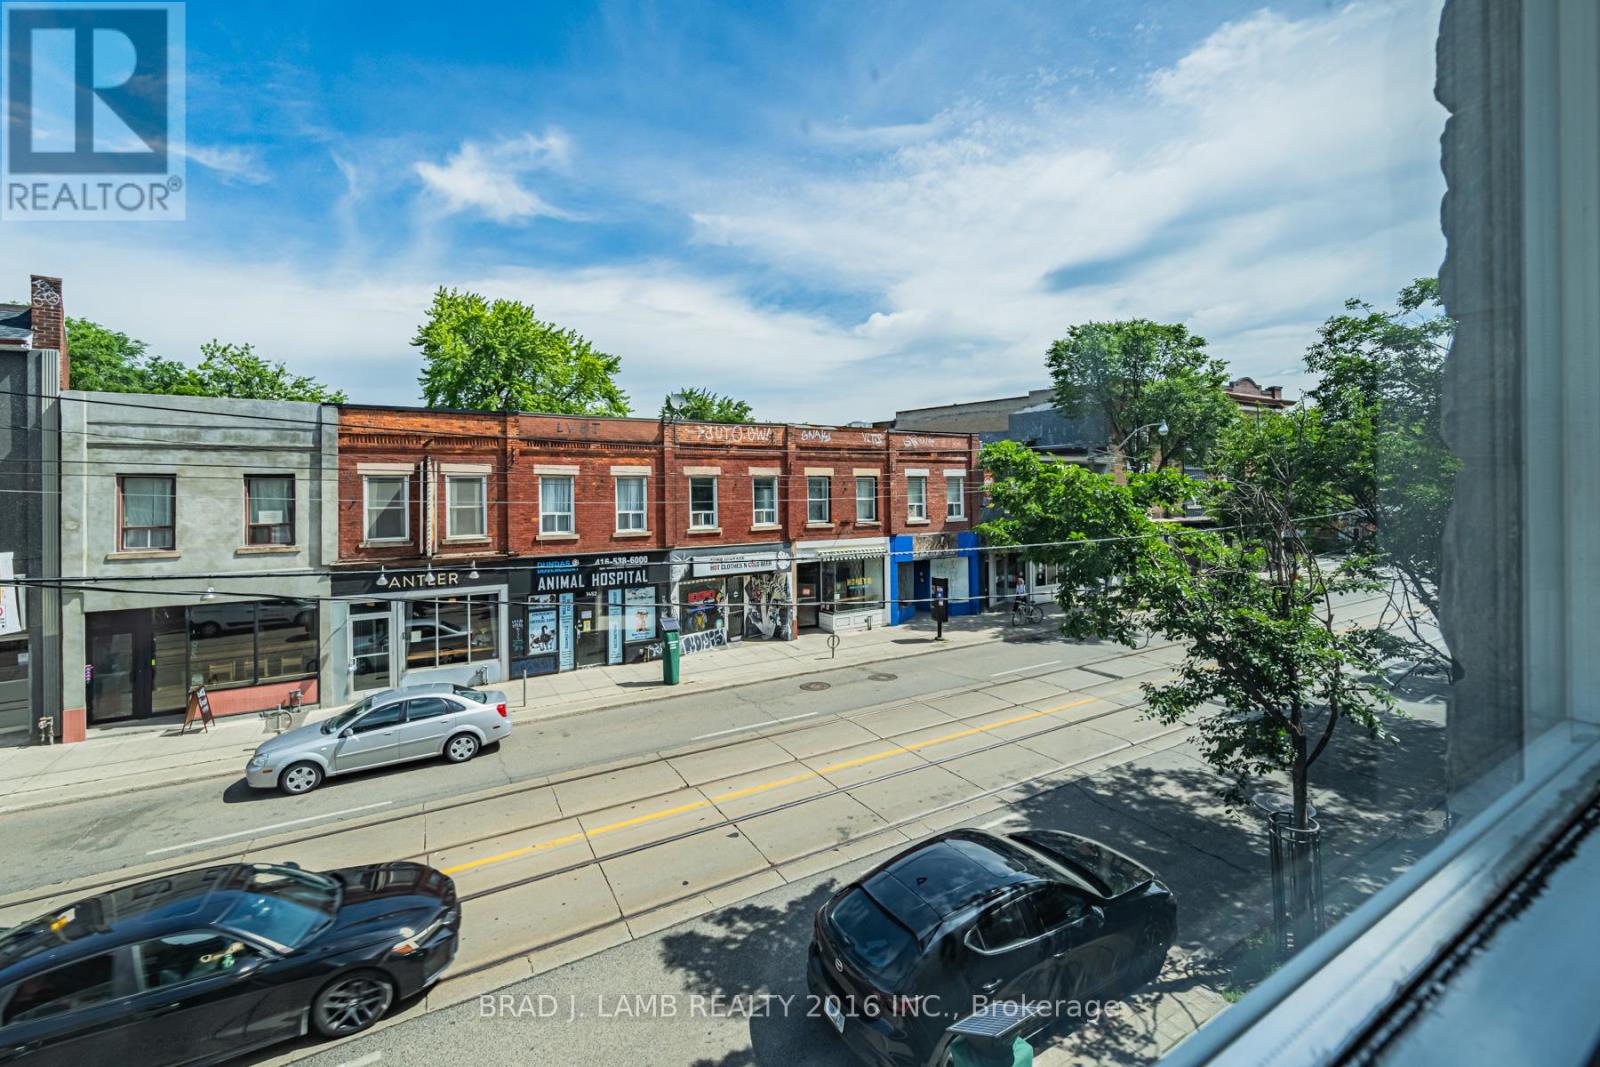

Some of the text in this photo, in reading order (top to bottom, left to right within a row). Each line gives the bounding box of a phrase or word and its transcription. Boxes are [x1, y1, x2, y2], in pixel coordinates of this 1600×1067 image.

[537, 560, 571, 568] DUNDAS
[595, 556, 648, 566] 416-538-6000
[537, 570, 648, 591] ANIMAL HOSPITAL
